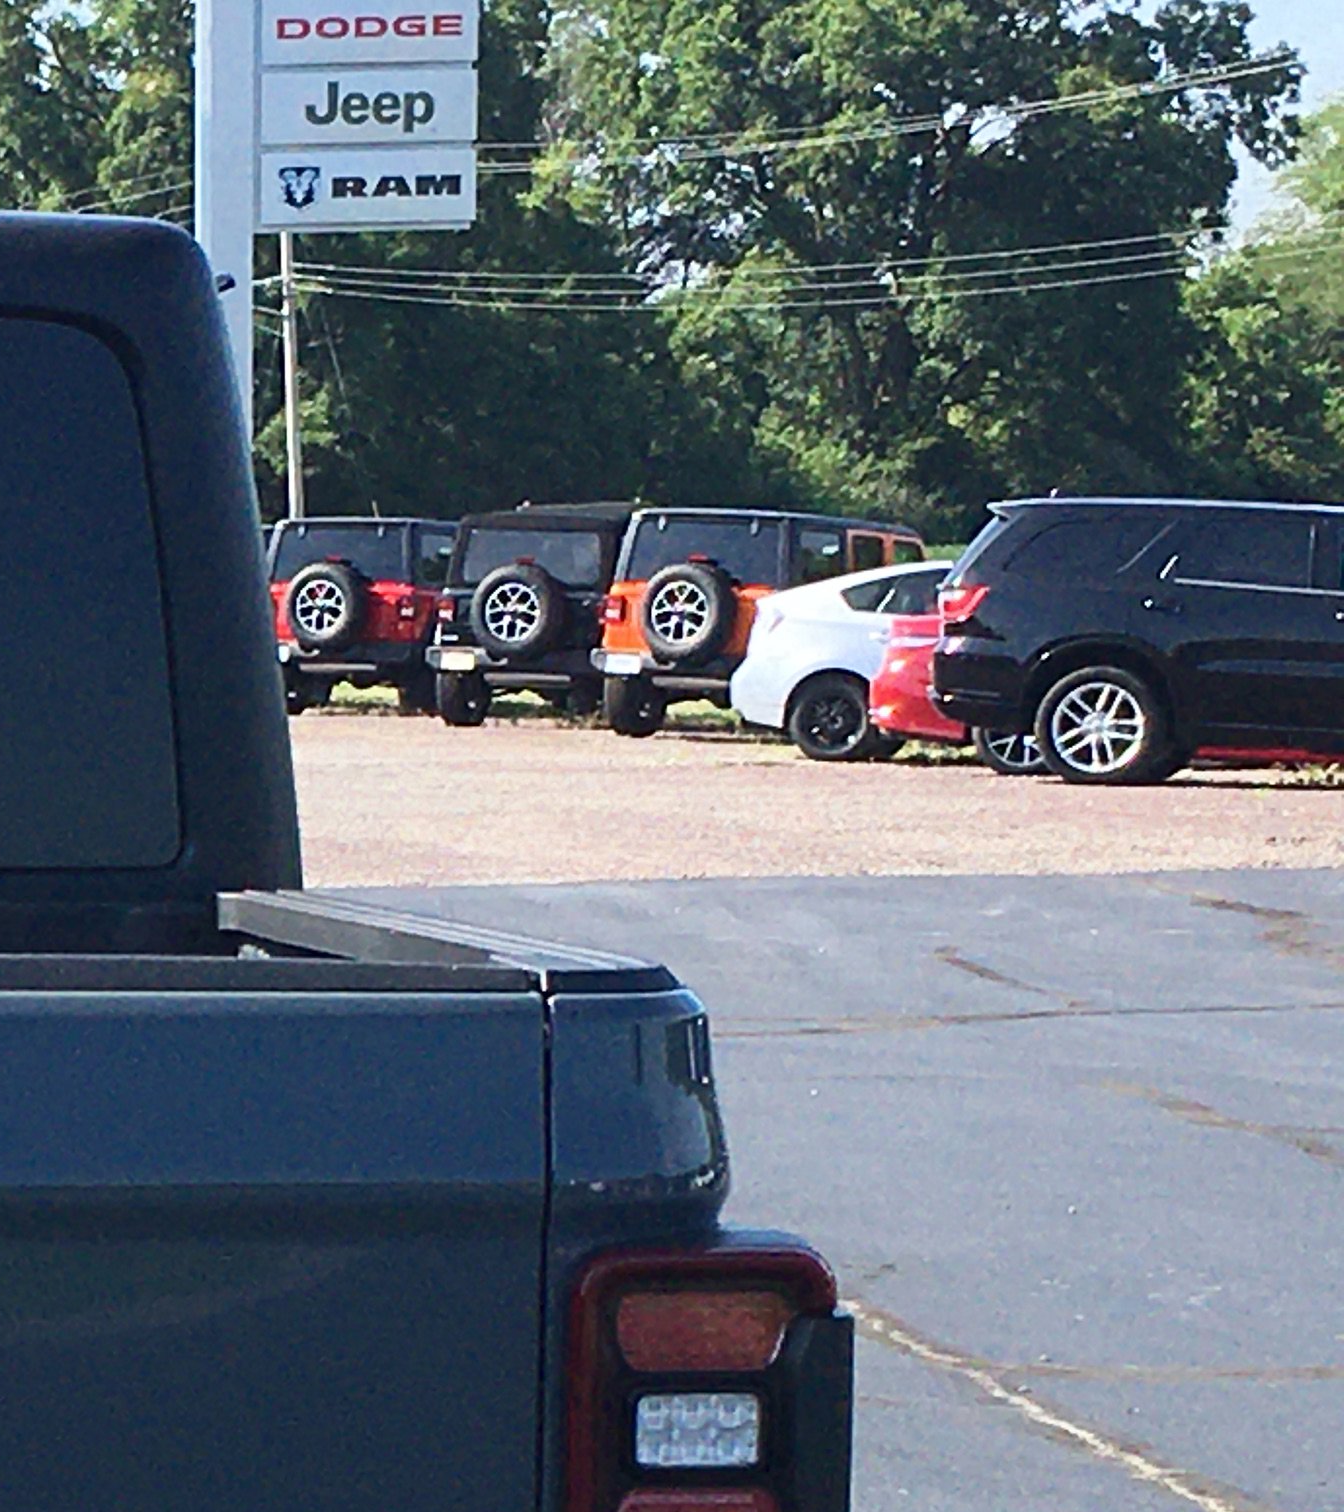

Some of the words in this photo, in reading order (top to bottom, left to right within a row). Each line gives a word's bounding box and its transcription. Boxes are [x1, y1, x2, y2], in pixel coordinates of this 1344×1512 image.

[276, 14, 463, 40] DODGE
[304, 80, 435, 133] Jeep
[331, 174, 462, 199] RAM
